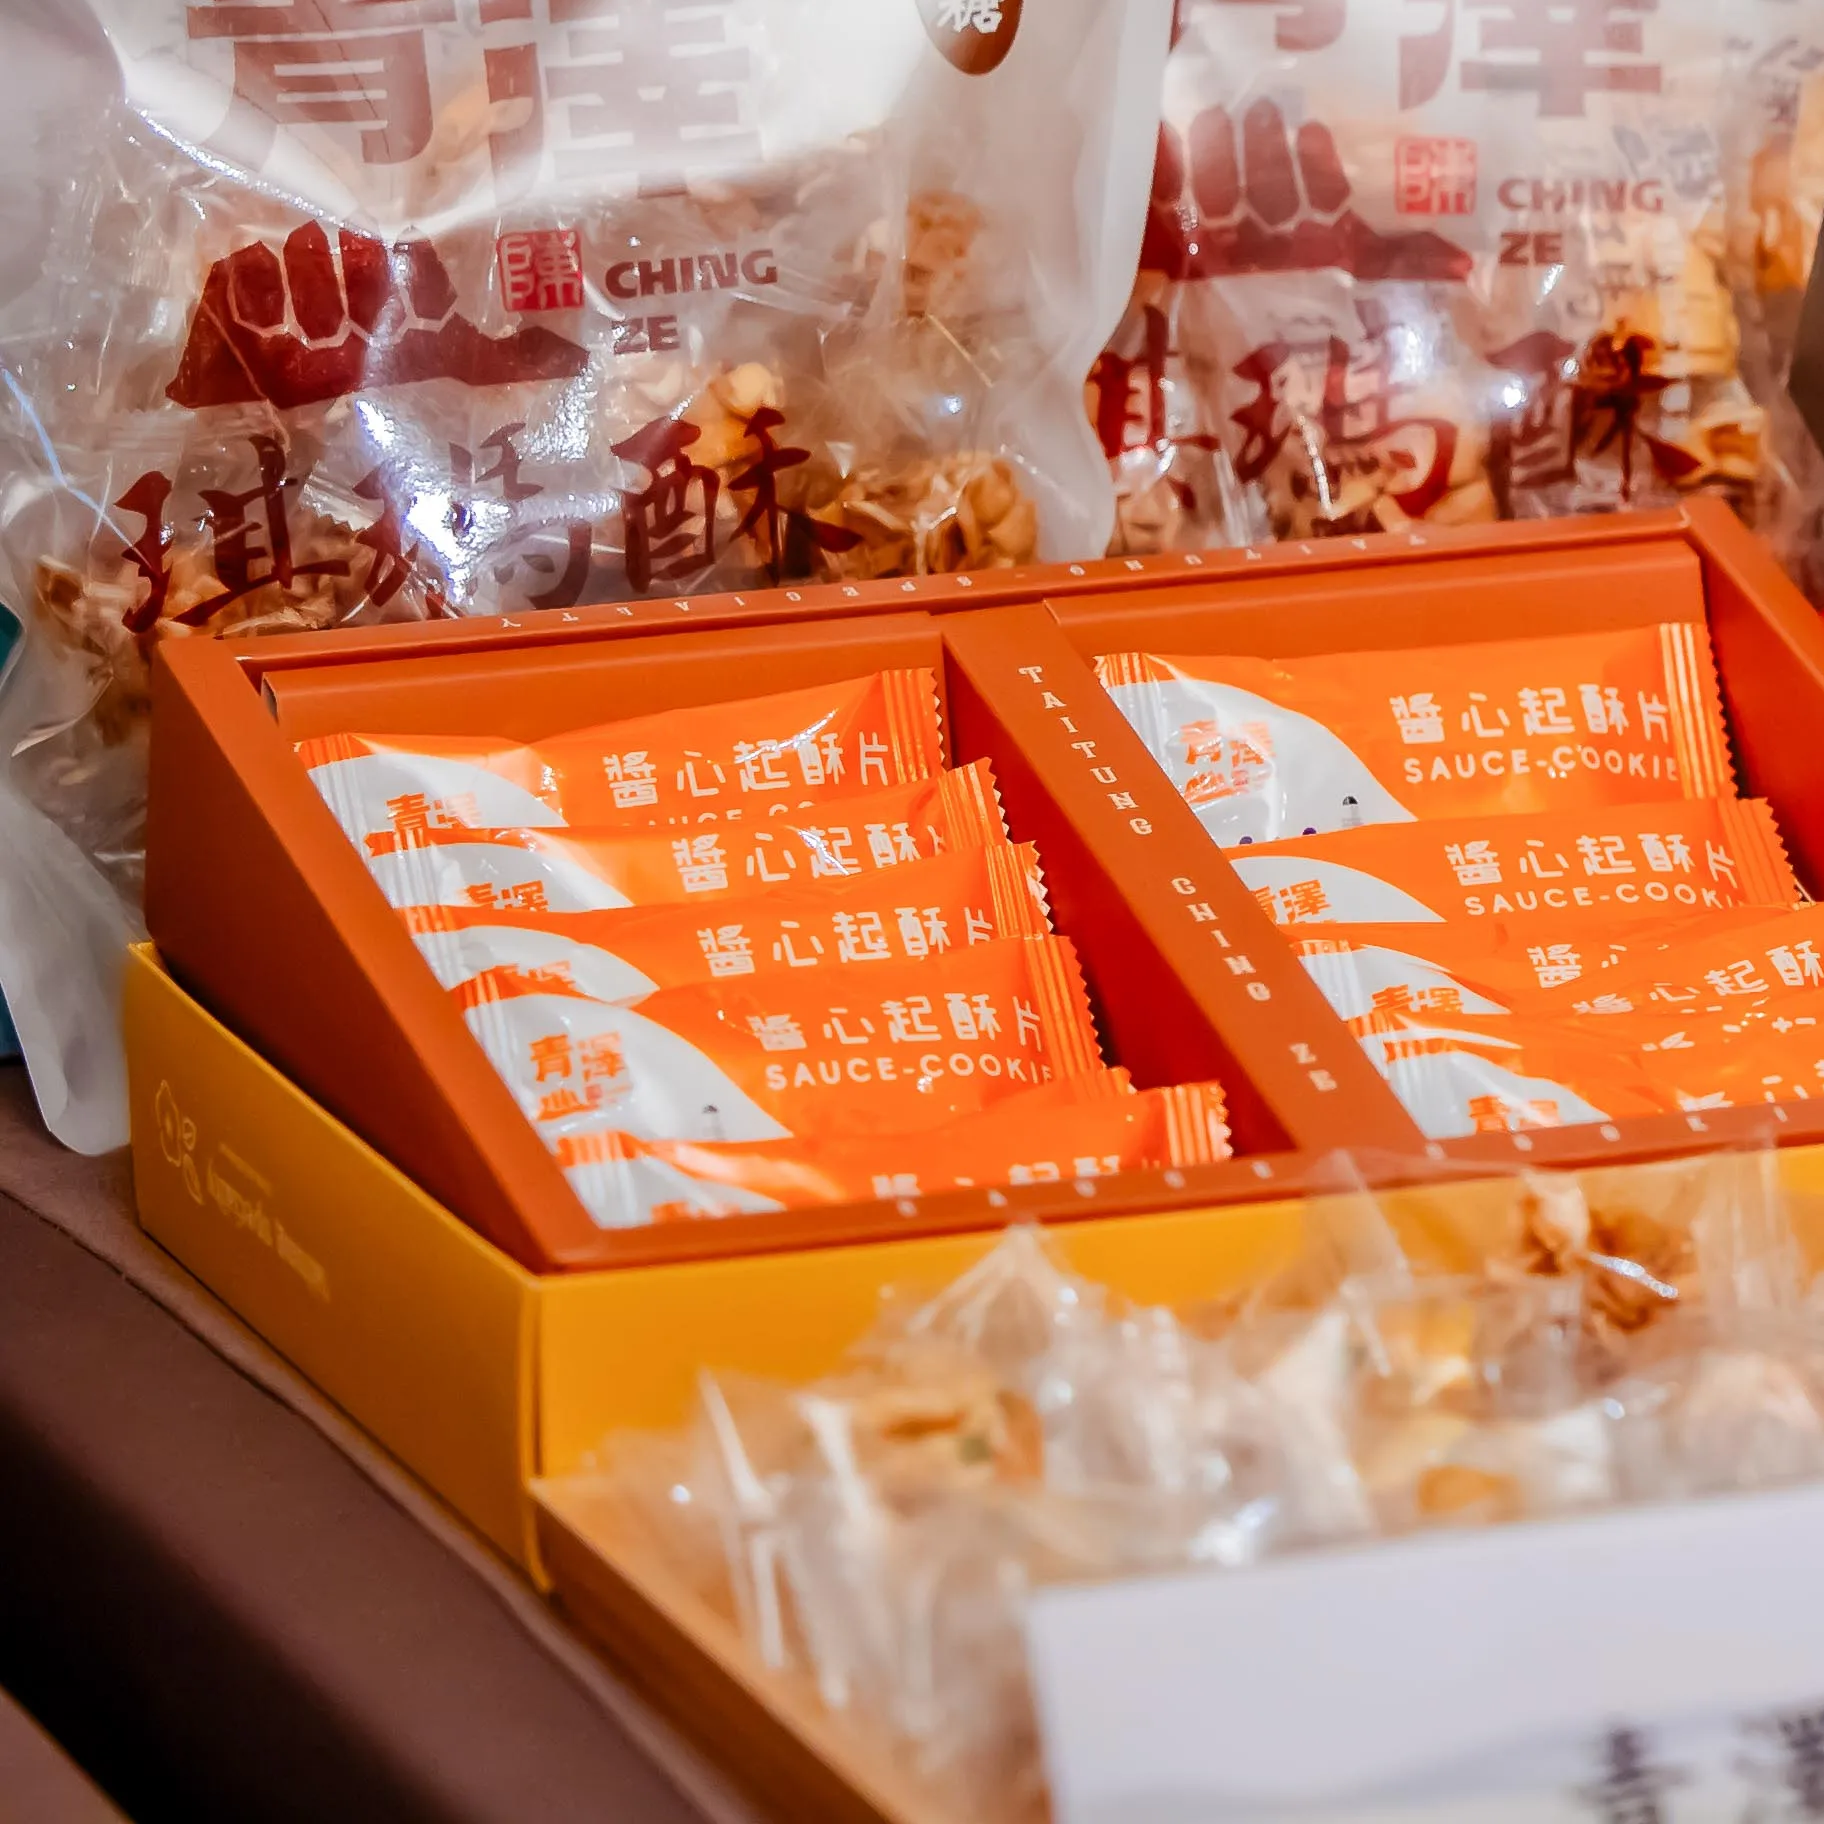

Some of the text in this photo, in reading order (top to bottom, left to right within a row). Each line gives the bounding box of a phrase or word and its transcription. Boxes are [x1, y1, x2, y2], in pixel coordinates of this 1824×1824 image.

[1497, 177, 1664, 214] CHING
[604, 248, 779, 300] CHING
[1499, 230, 1566, 266] ZE
[612, 314, 682, 356] ZE
[1389, 683, 1669, 745] 醬心起酥片
[602, 731, 890, 809] 醬心起酥片
[1403, 745, 1680, 785] SAUCE-COOKIE
[1018, 665, 1339, 1093] TAITUNG CHING ZE
[1443, 832, 1739, 889] 醬心起酥片
[1464, 881, 1736, 916] SAUCE-COOK
[696, 906, 994, 978] 醬心起酥片
[745, 992, 1043, 1052] 醬心起酥片
